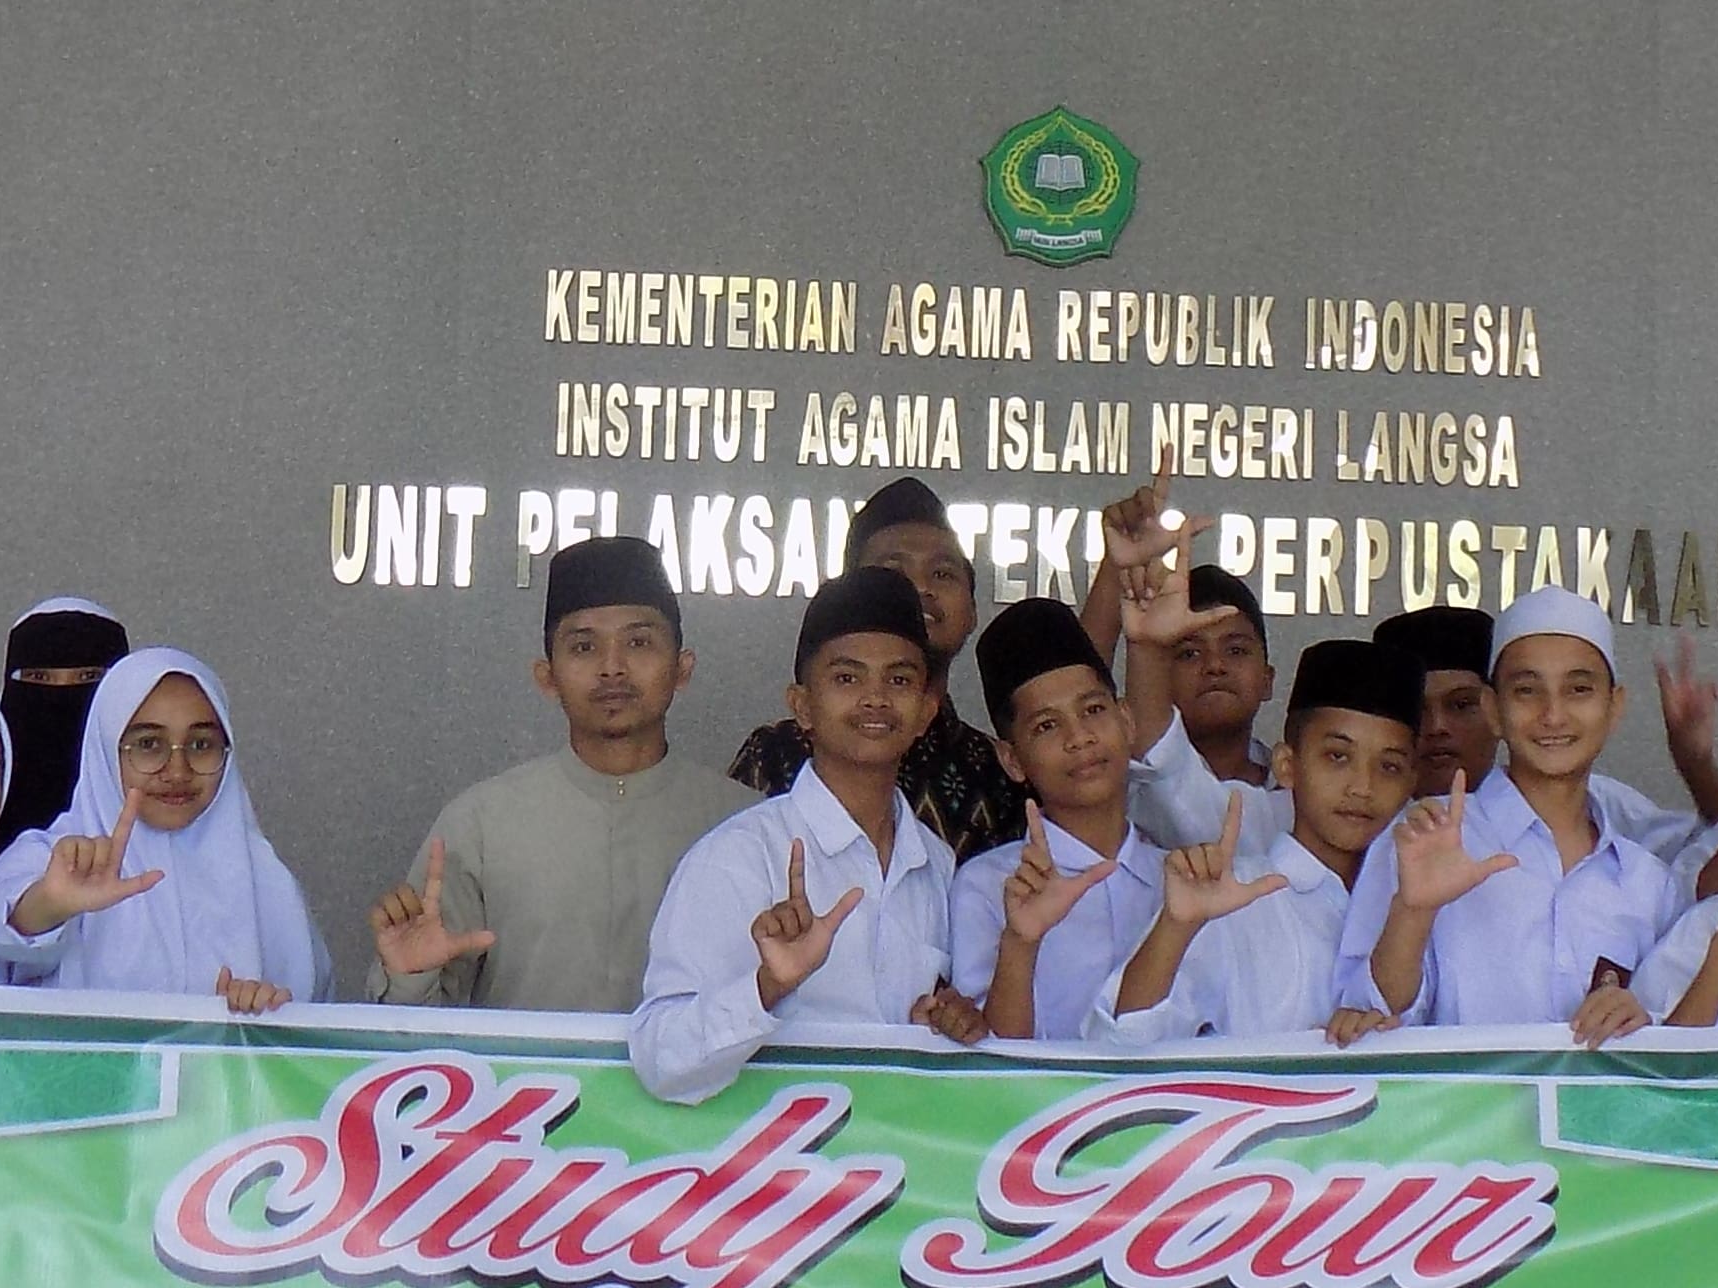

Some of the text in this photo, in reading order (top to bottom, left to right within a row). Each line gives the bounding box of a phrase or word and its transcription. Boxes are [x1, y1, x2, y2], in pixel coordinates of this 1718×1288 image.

[544, 268, 1542, 378] KEMENTERIAN AGAMA REPUBLIK INDONESIA
[555, 381, 1521, 488] INSTITUT AGAMA ISLAM NEGERI LANGSA
[329, 484, 486, 588] UNIT
